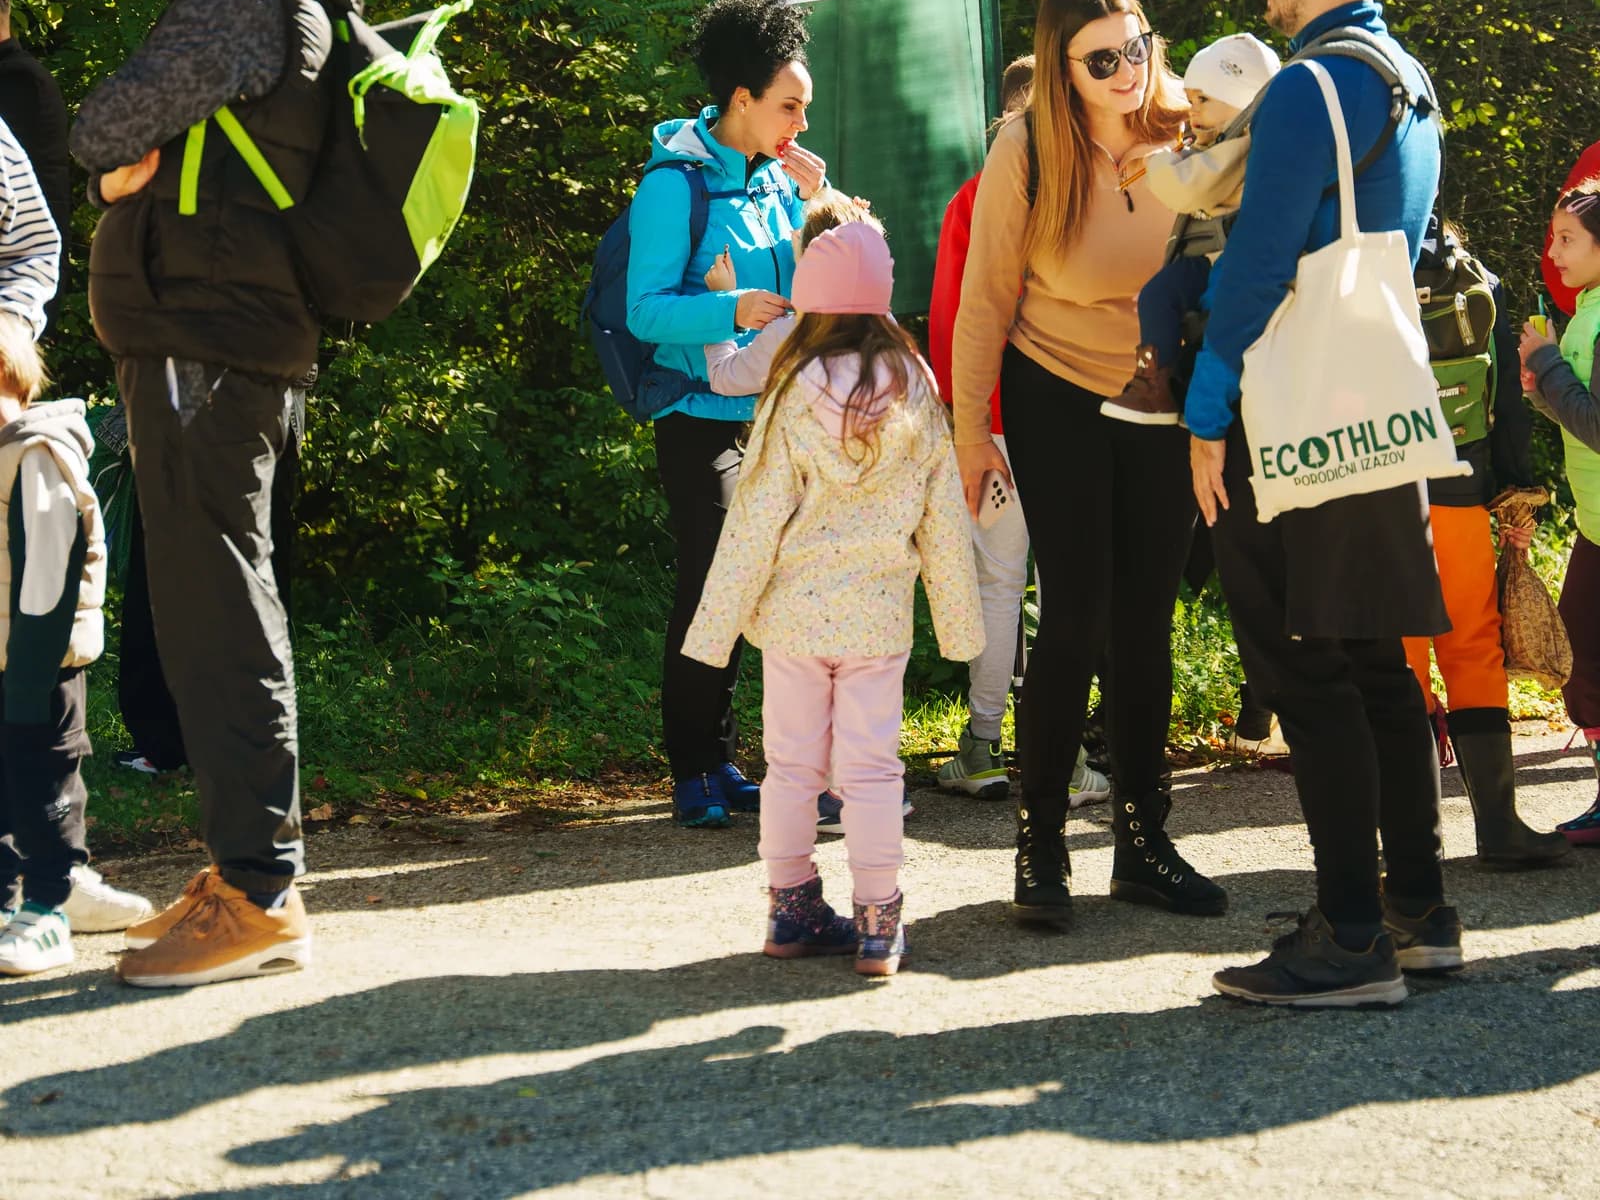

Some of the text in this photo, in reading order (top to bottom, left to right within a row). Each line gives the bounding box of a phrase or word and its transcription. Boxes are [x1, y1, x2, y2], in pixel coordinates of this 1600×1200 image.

[1259, 407, 1438, 480] ECOTHLON
[1293, 450, 1406, 486] PORODIČNI IZAZOV
